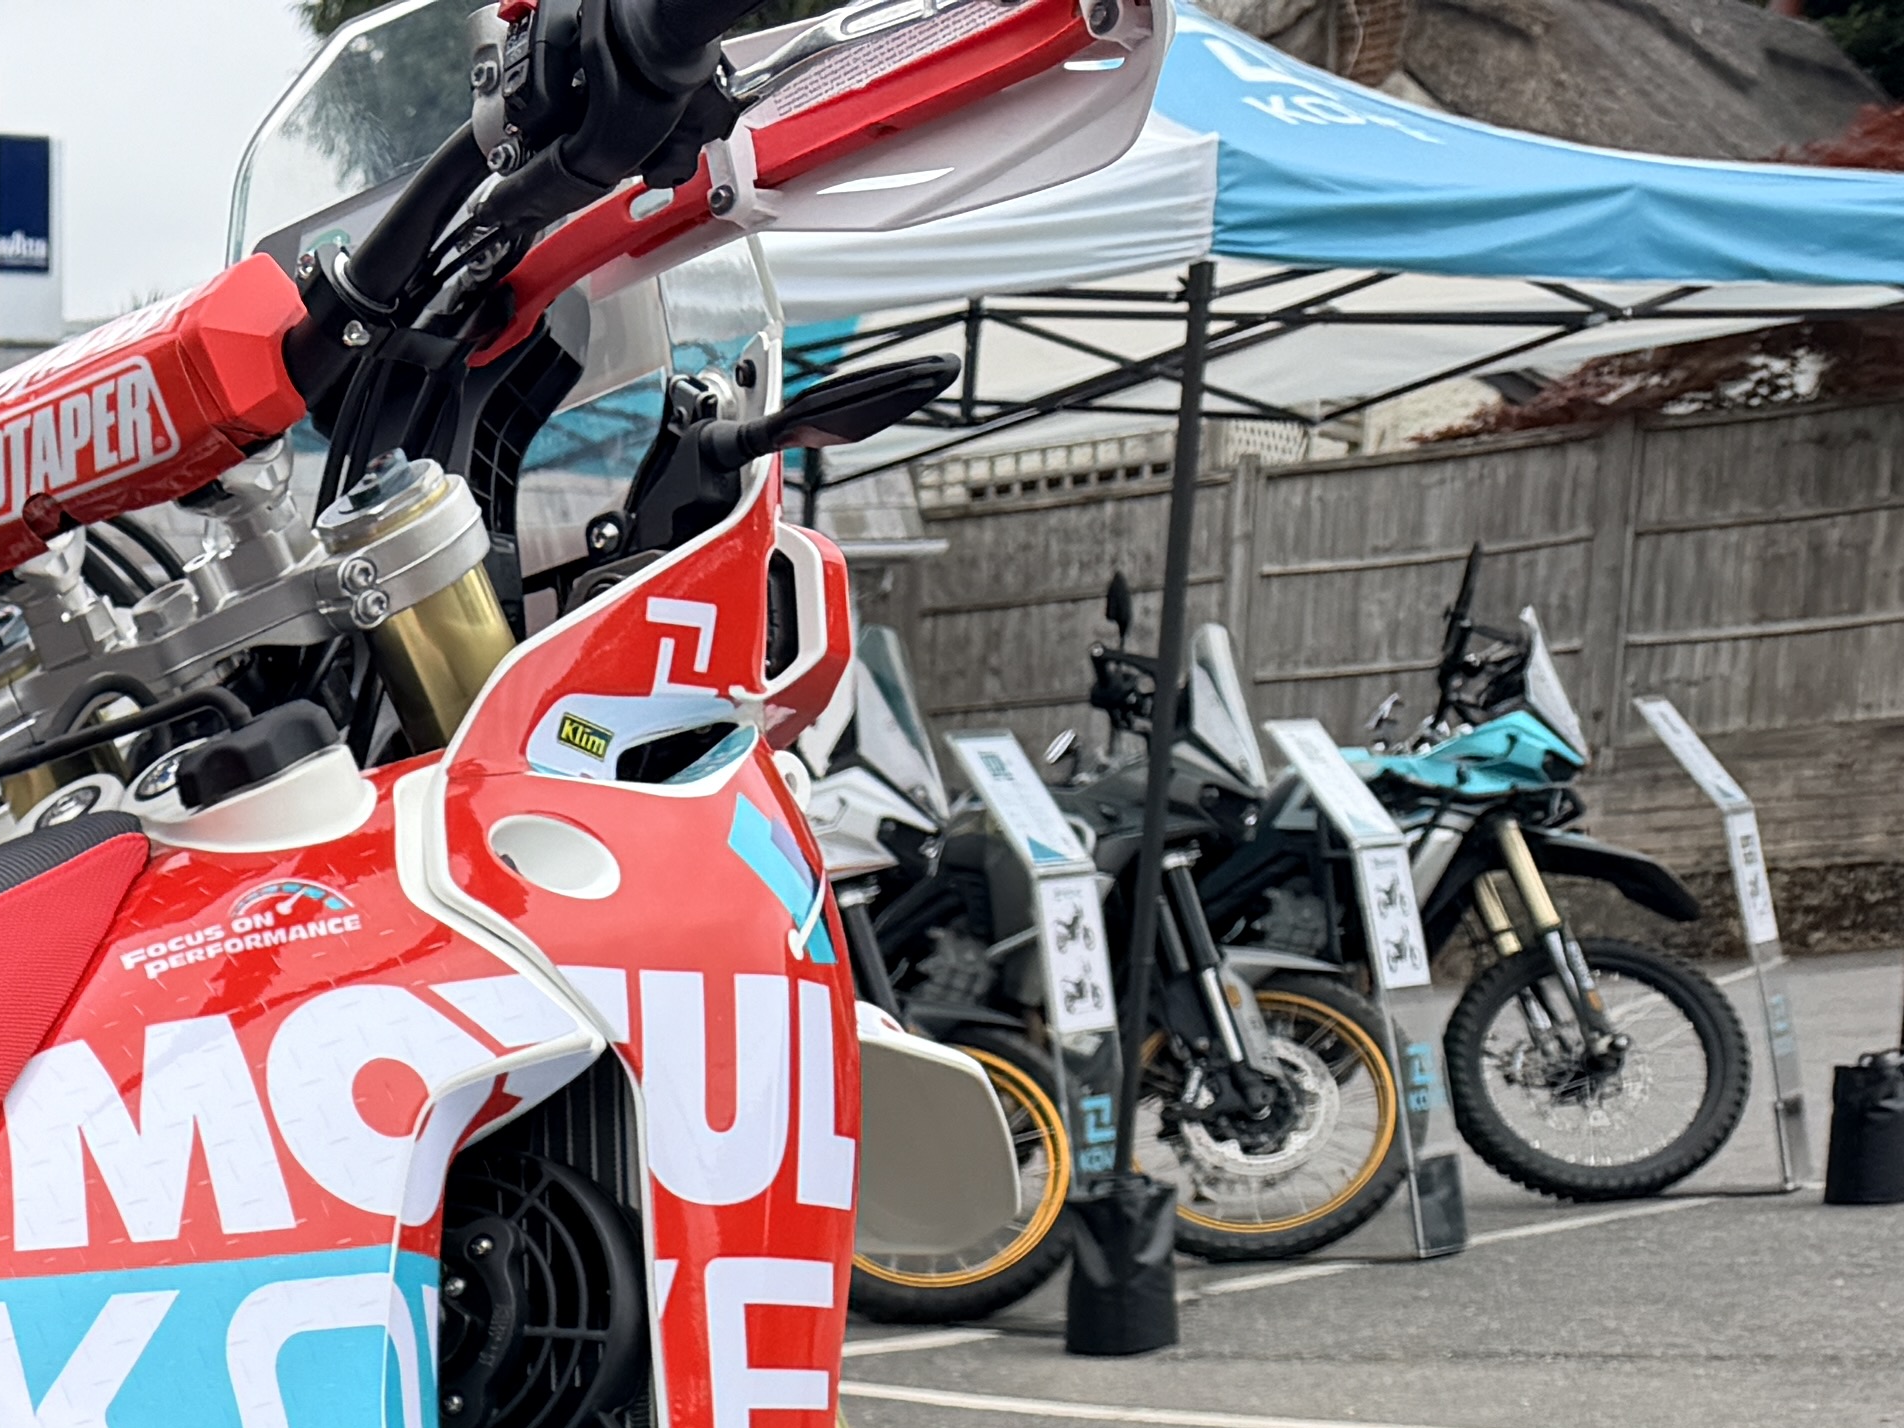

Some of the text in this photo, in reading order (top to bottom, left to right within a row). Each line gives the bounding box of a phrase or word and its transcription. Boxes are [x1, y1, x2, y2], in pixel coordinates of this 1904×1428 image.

[1242, 95, 1445, 144] KO
[560, 718, 607, 757] Klim
[119, 911, 275, 971] FOCUS ON
[143, 913, 362, 980] PERFORMANCE
[4, 965, 856, 1253] MOTUL
